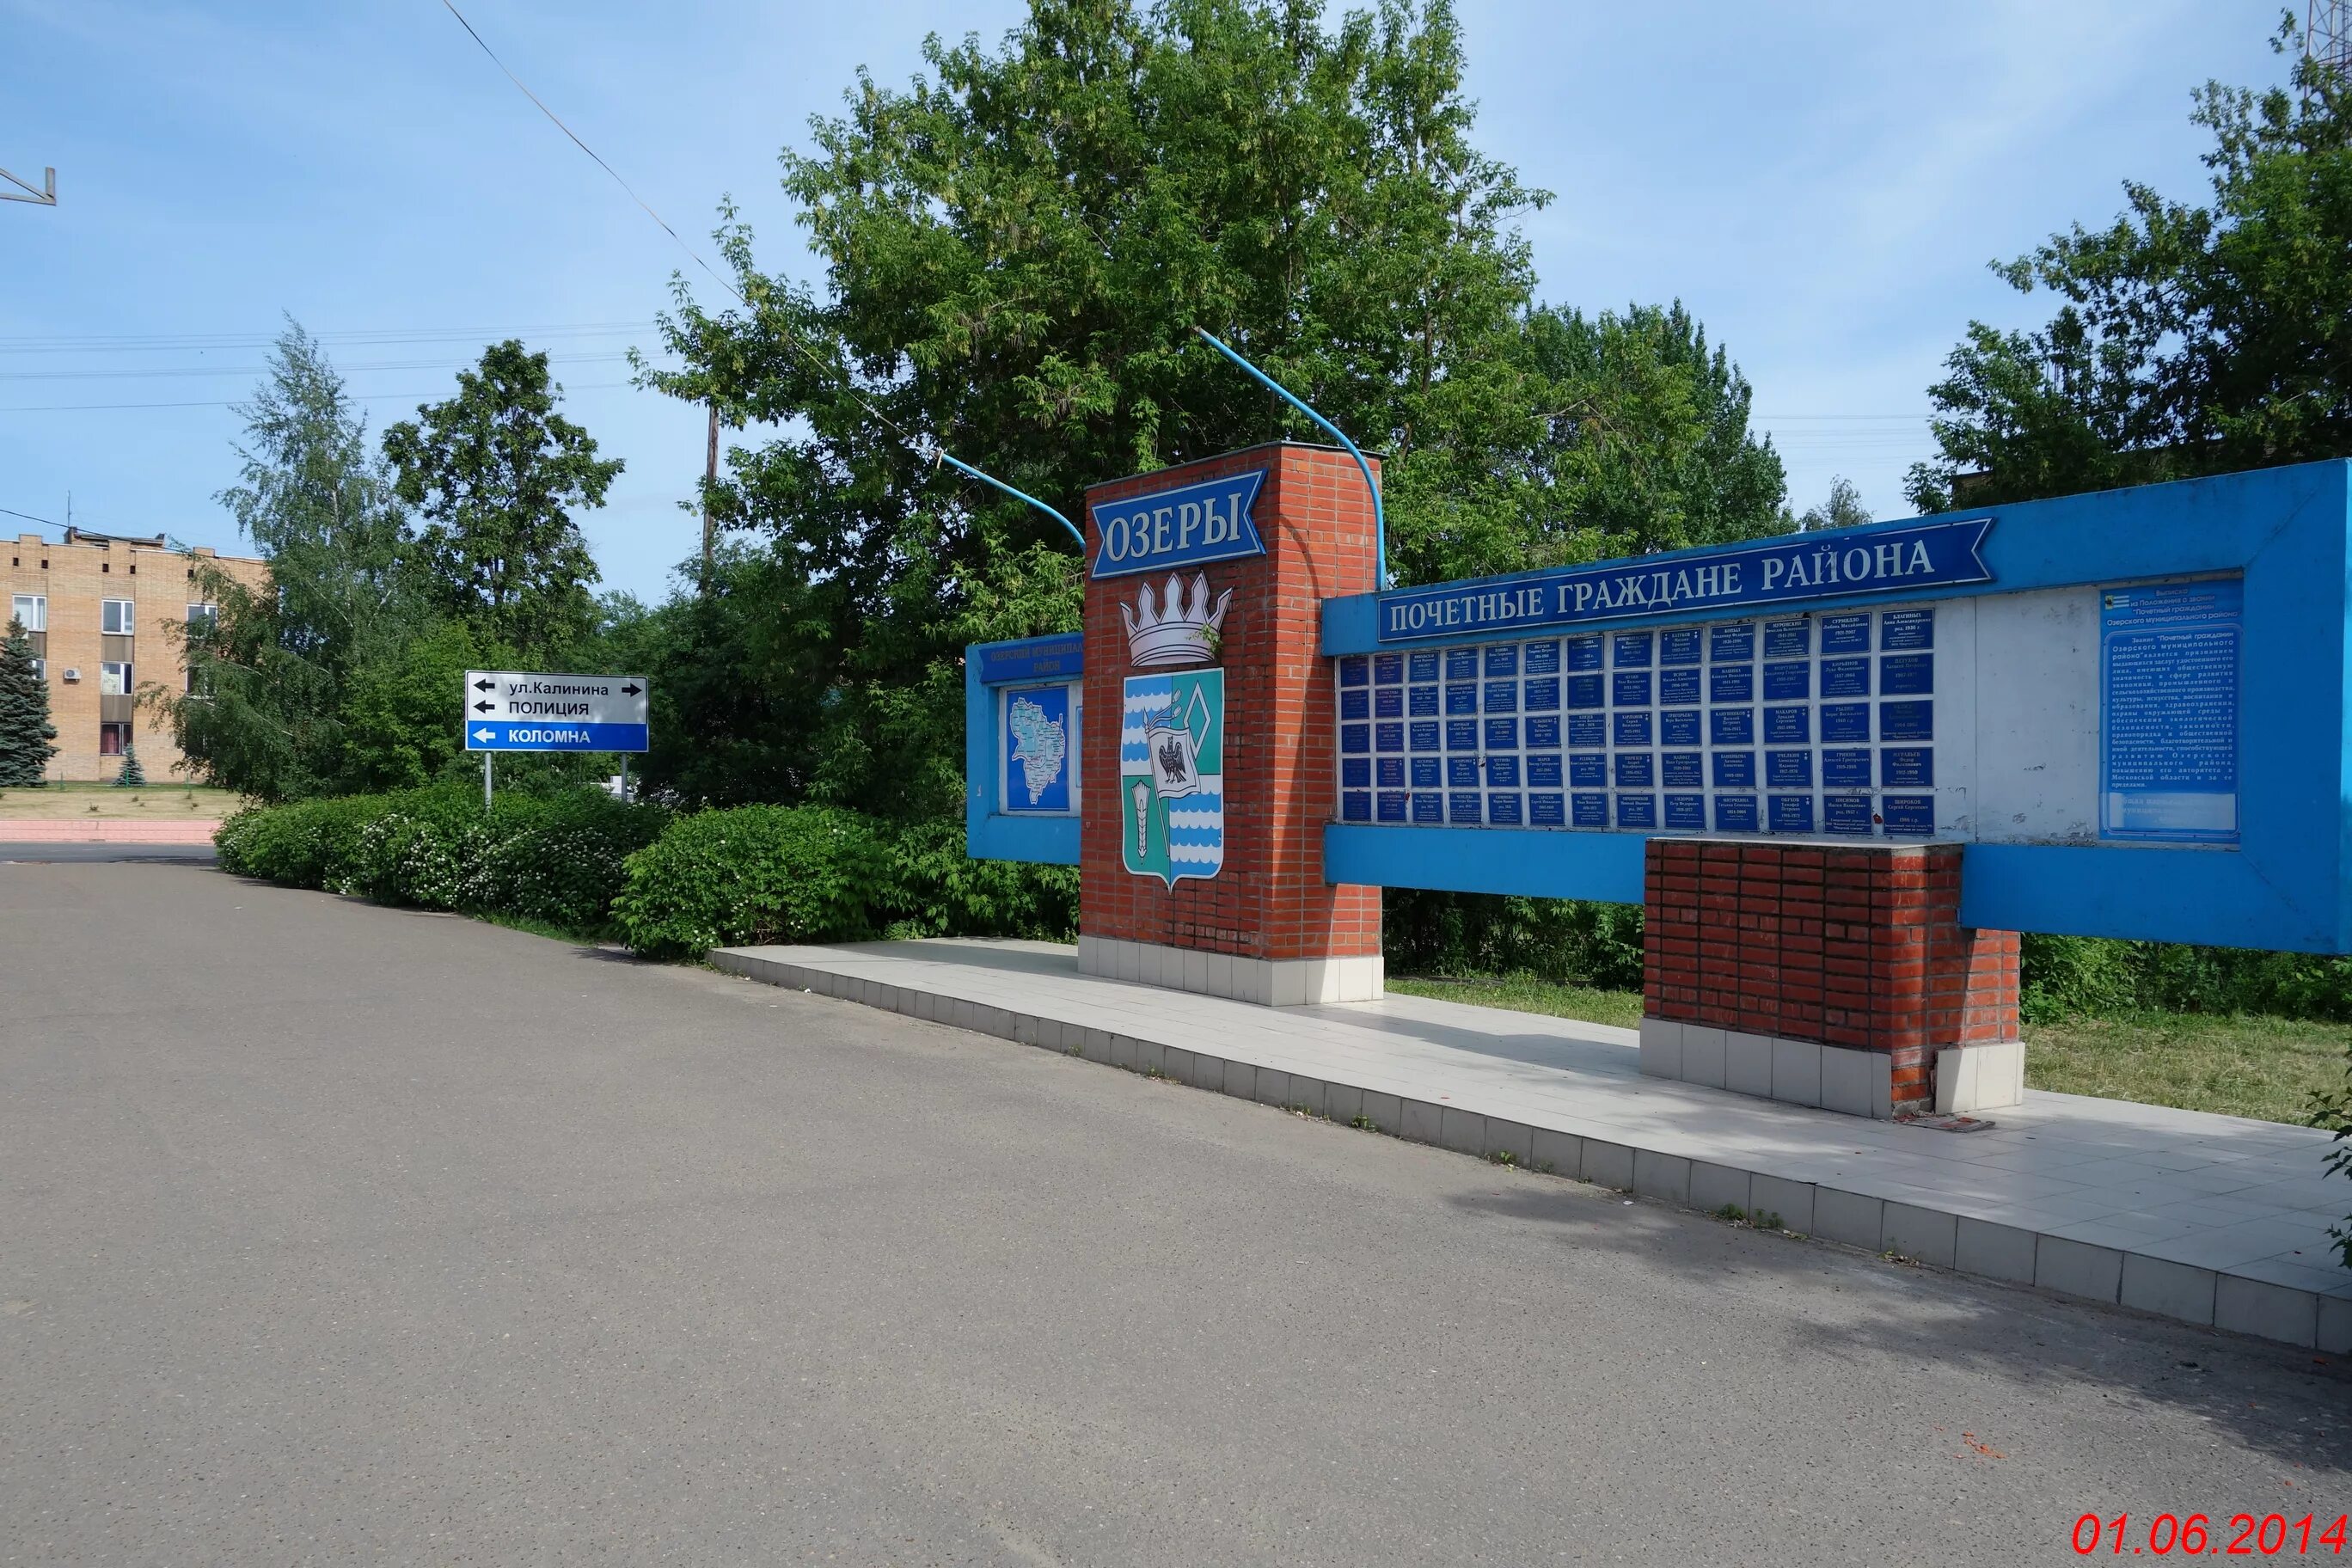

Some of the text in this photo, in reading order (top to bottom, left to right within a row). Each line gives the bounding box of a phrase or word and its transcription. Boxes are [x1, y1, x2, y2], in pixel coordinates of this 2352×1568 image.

[1106, 492, 1242, 562] ОЗЕРЫ
[1389, 539, 1935, 633] ПОЧЕТНЫЕ ГРАЖДАНЕ РАЙОНА
[2106, 617, 2144, 626] Озерского
[2160, 640, 2233, 649] муниципального
[509, 682, 609, 696] ул.Калинина
[509, 701, 589, 716] ПОЛИЦИЯ
[508, 729, 591, 744] КОЛОМНА
